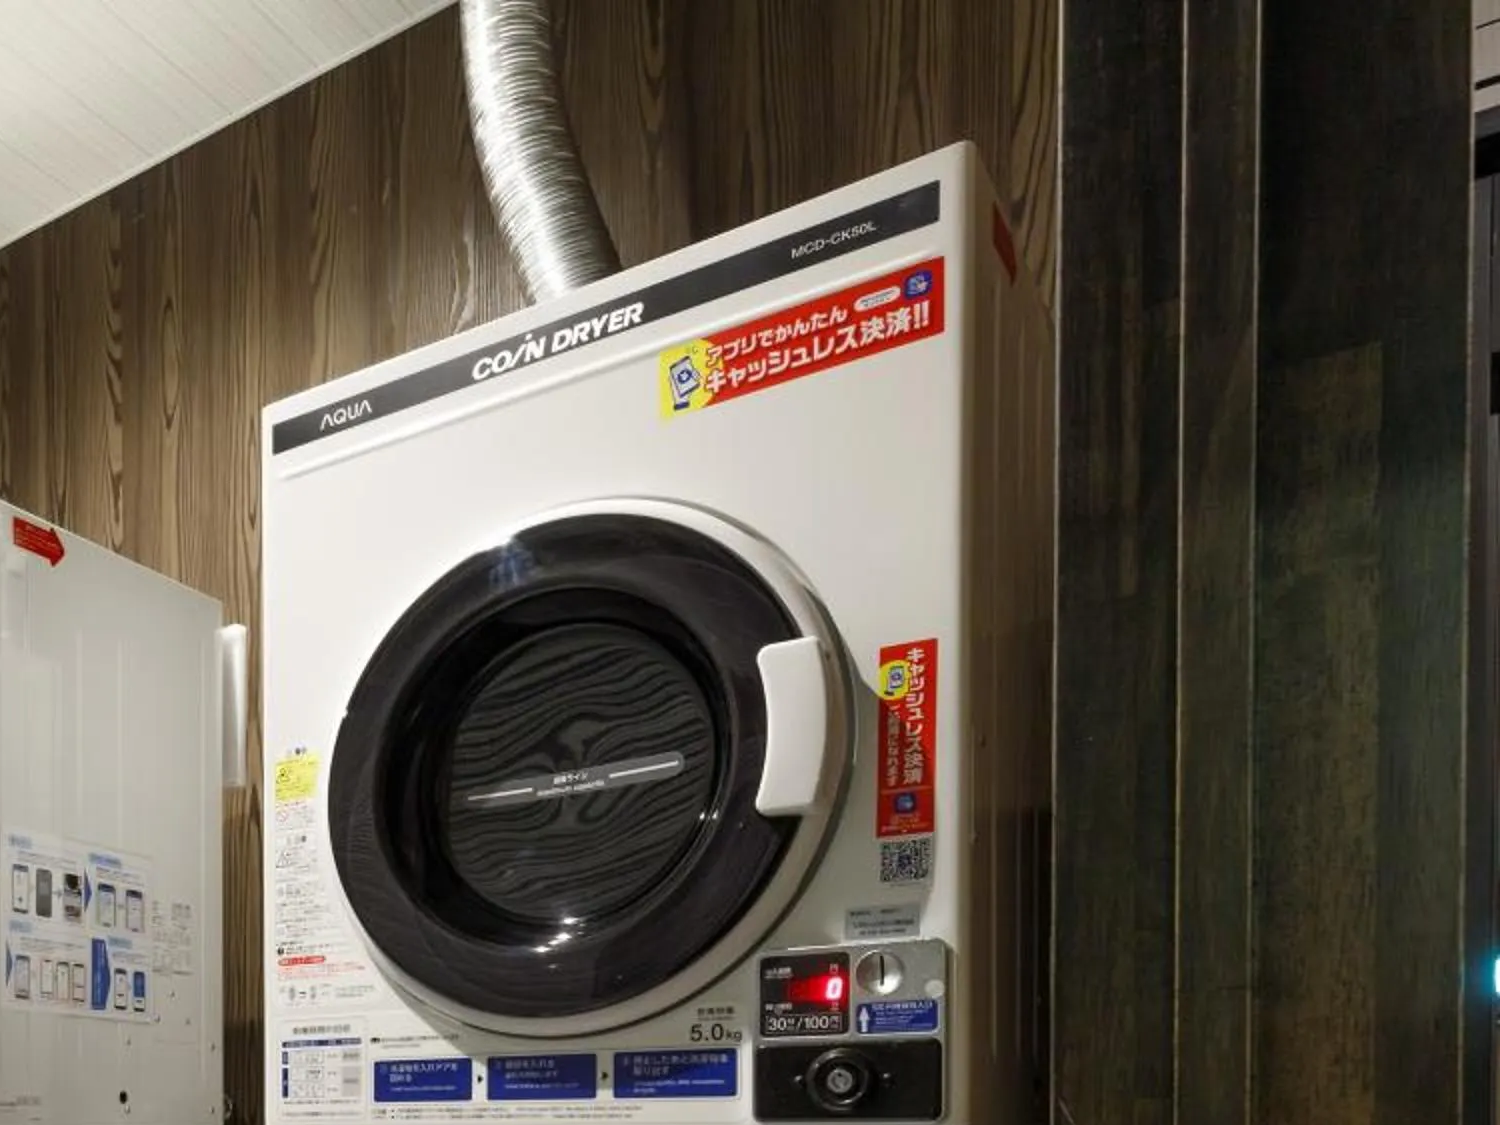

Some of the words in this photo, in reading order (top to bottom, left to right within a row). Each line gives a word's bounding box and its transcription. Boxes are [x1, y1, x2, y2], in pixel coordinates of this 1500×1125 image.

[320, 400, 372, 431] AQUA
[551, 301, 644, 353] DRYER
[706, 305, 848, 367] アプリでかんたん
[903, 647, 925, 784] キャッシュレス決済
[826, 977, 843, 1000] 0
